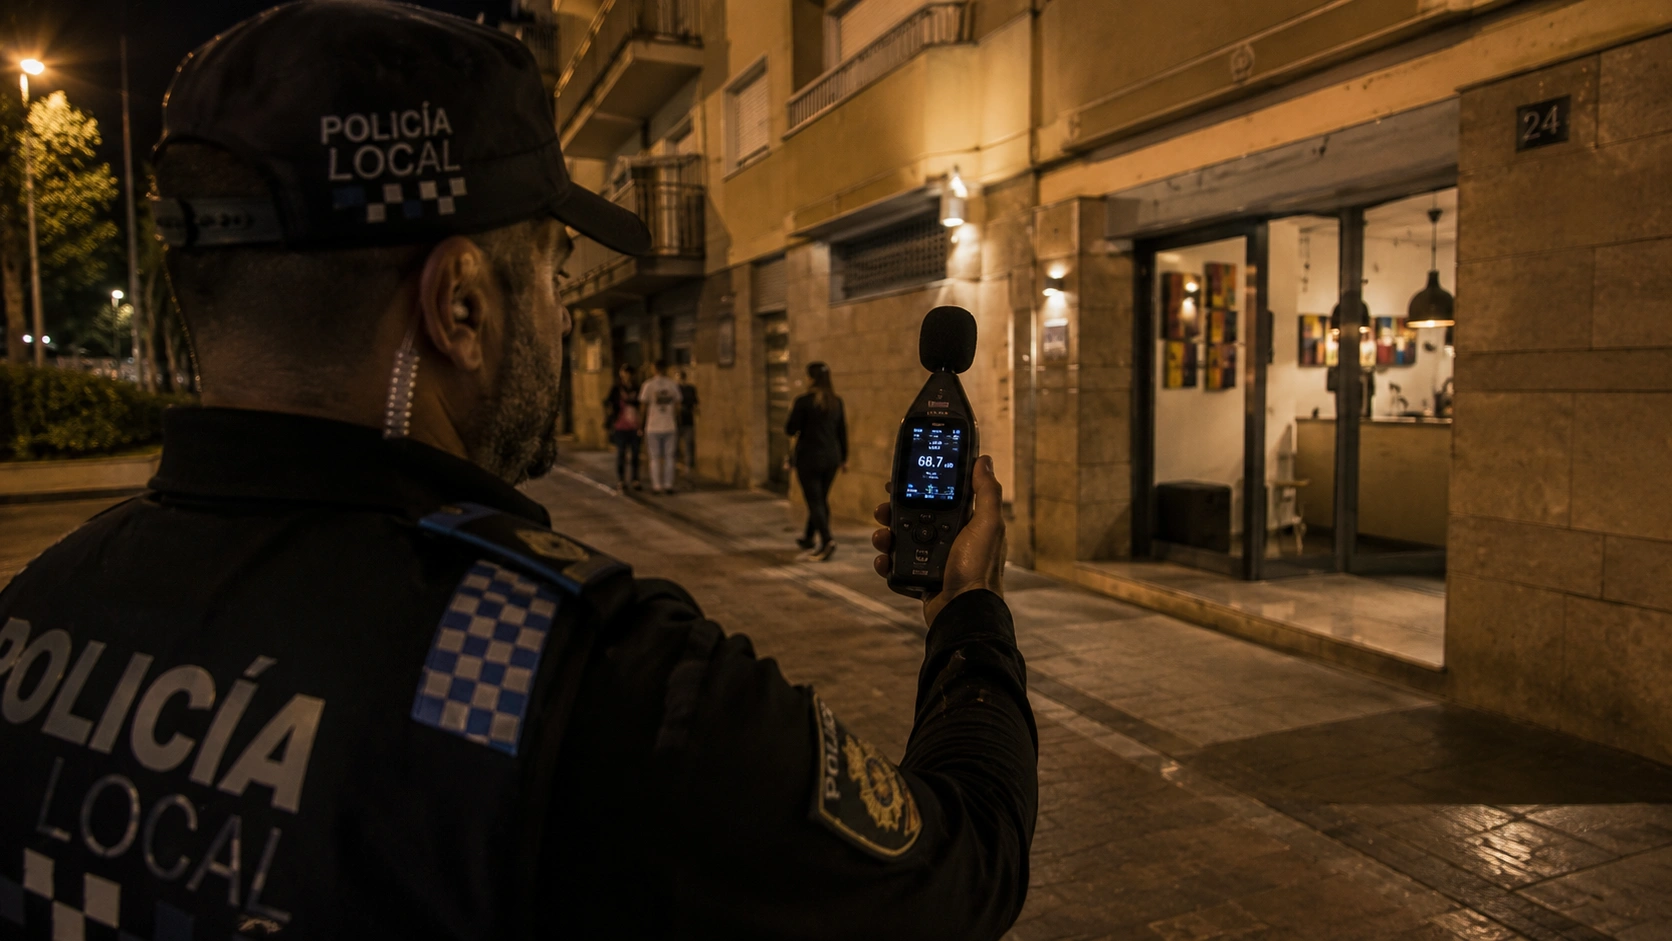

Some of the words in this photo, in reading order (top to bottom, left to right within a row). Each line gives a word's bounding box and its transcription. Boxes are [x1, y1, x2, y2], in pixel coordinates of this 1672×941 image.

[320, 100, 453, 144] POLICÍA
[1522, 104, 1561, 142] 24
[329, 140, 460, 180] LOCAL
[917, 456, 944, 468] 68.7
[37, 757, 291, 922] LOCAL
